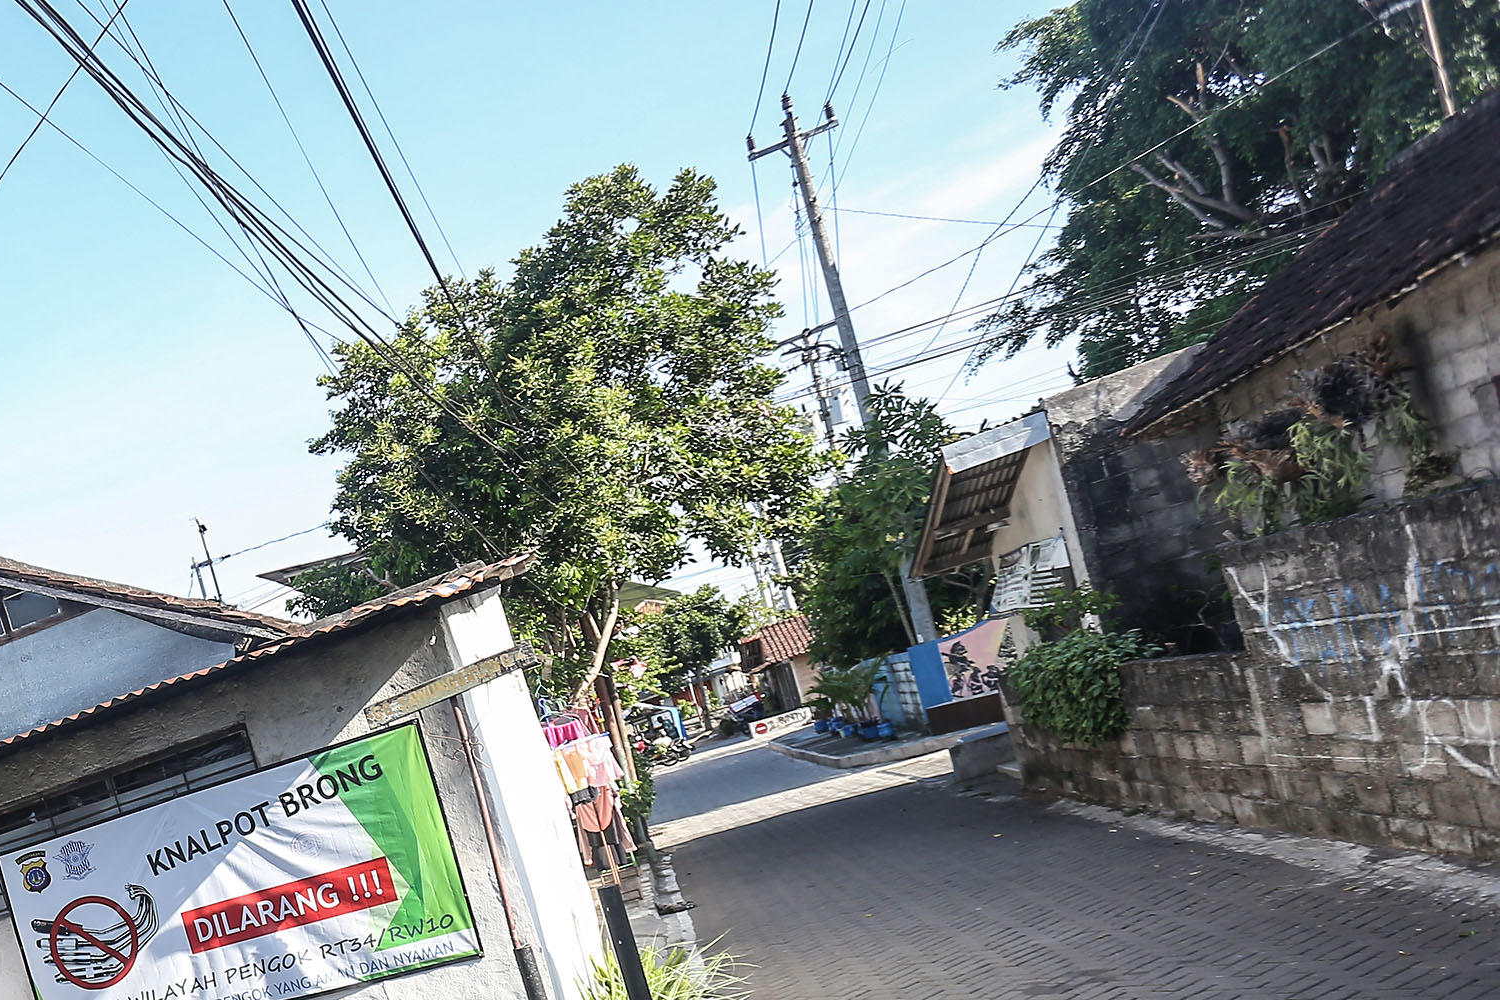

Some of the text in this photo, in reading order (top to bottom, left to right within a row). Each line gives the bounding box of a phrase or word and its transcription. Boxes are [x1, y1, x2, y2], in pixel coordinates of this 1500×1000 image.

[146, 801, 270, 876] KNALPOT
[278, 754, 384, 818] BRONG
[193, 882, 340, 942] DILARANG
[224, 948, 314, 985] PENGOK
[319, 913, 454, 960] RT34/RW10
[276, 976, 312, 996] YANG
[360, 956, 391, 976] DAN
[393, 940, 455, 971] NYAMAN
